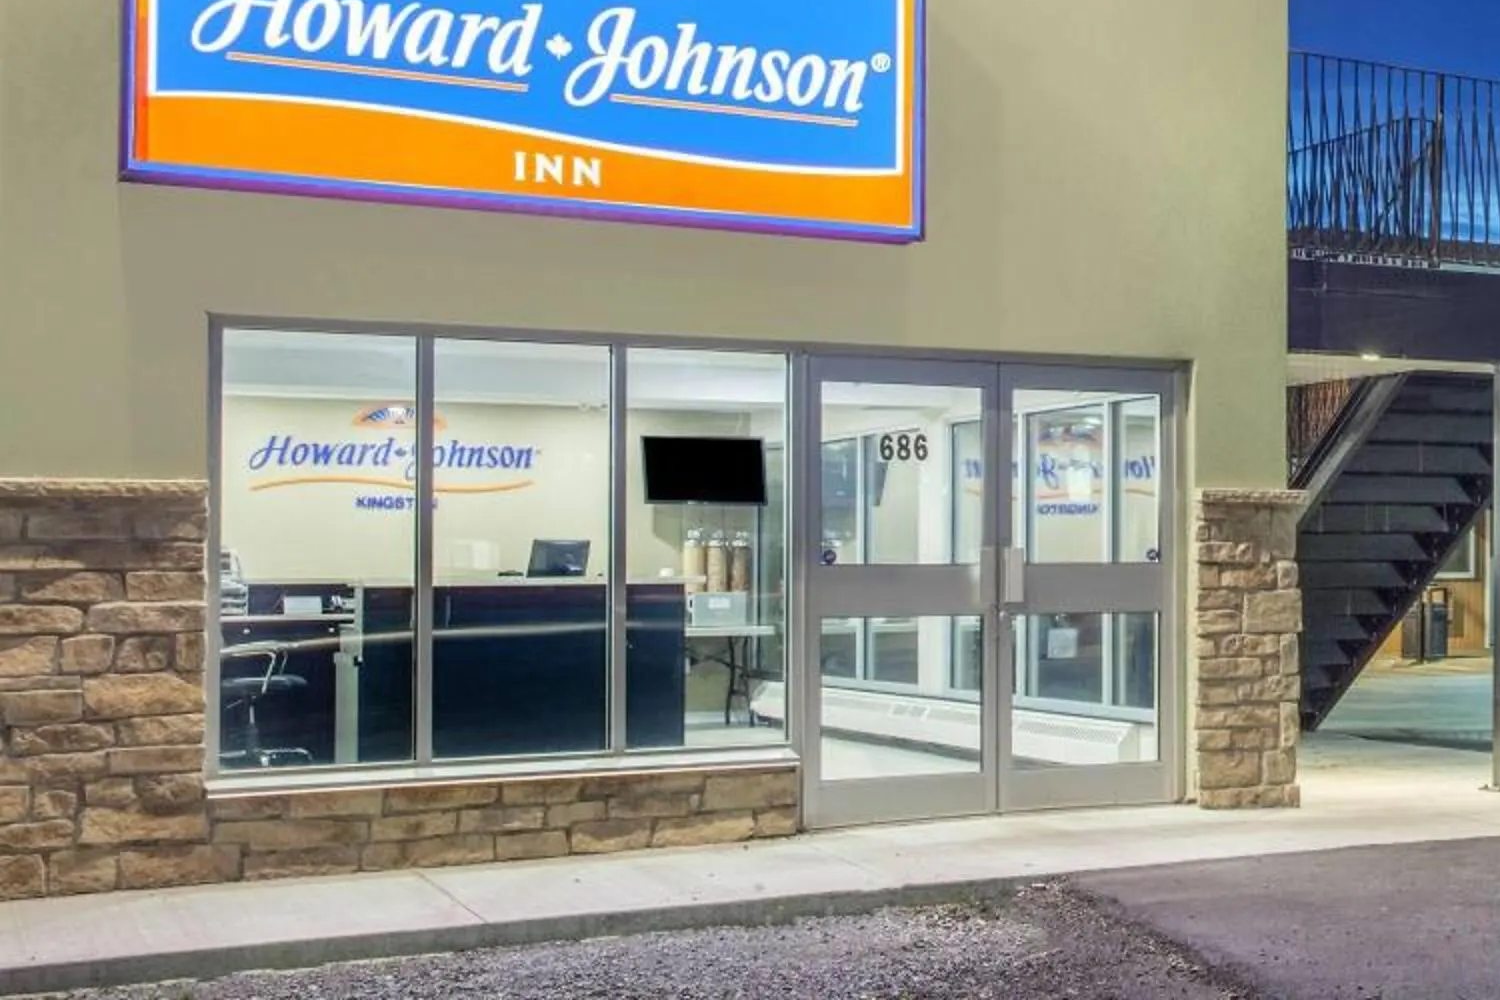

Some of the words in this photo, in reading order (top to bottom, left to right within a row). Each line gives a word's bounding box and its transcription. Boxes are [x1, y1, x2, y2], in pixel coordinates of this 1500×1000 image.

[512, 151, 602, 188] INN
[249, 435, 394, 470] Howard
[880, 433, 929, 461] 686
